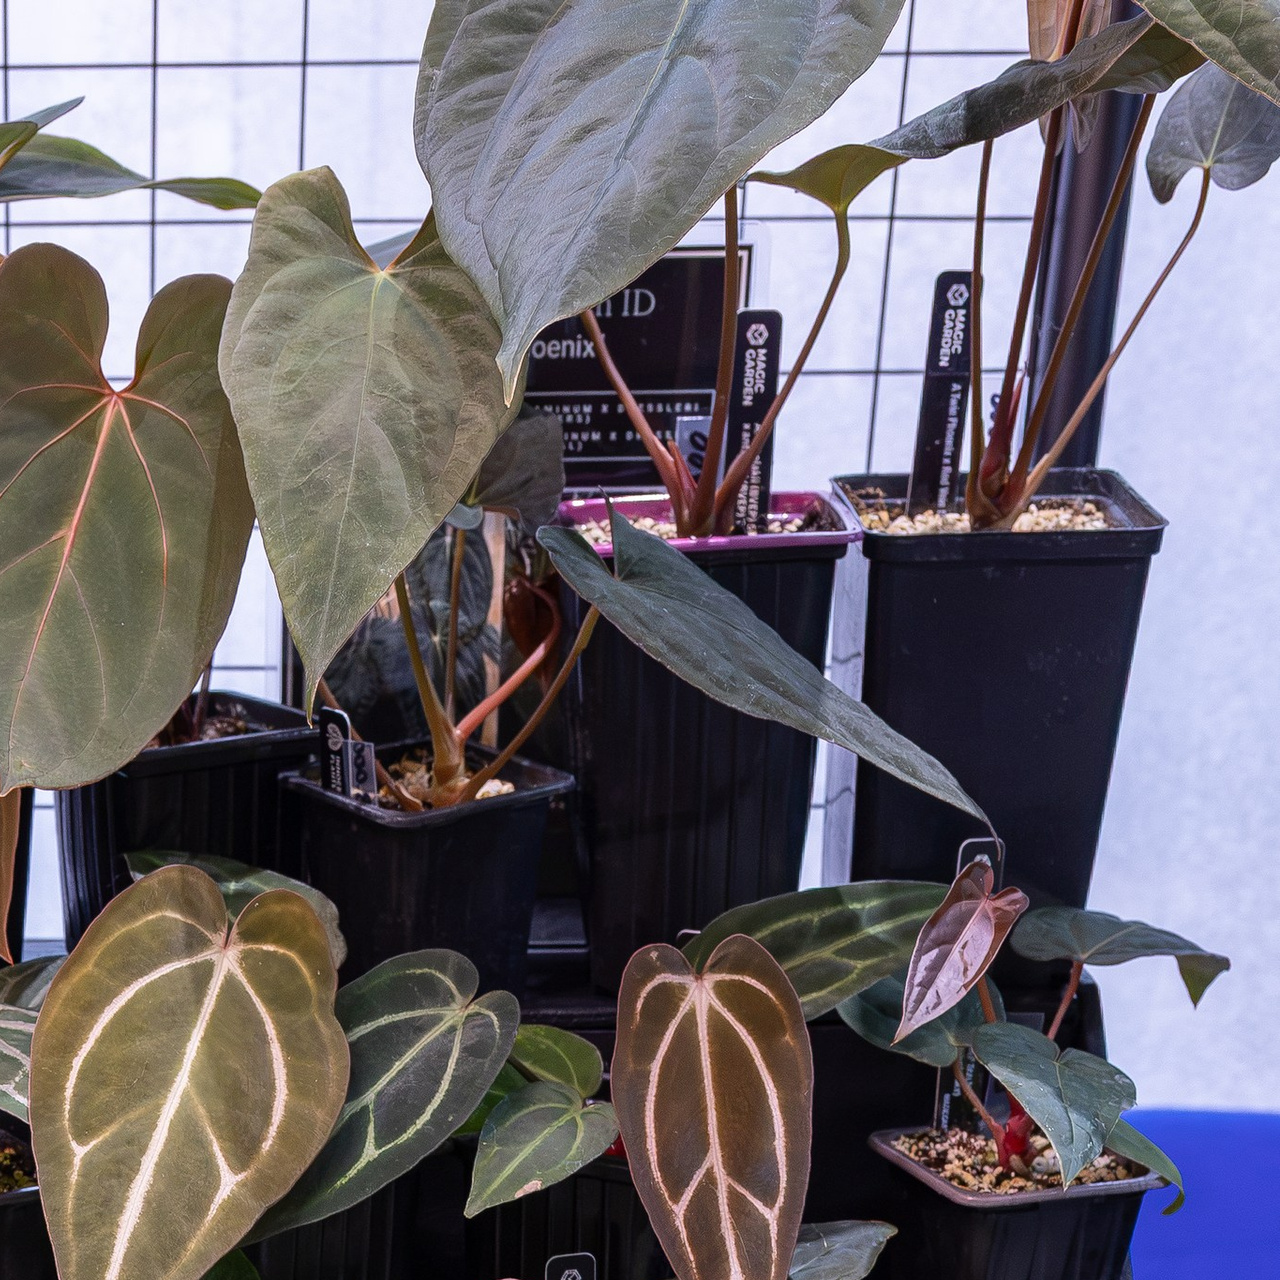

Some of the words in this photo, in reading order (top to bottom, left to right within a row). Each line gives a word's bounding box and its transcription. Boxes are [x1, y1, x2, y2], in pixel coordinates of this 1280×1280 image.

[938, 309, 955, 367] GARDEN
[952, 309, 966, 354] MAGIC
[742, 349, 756, 407] GARDEN
[754, 349, 767, 394] MAGIC
